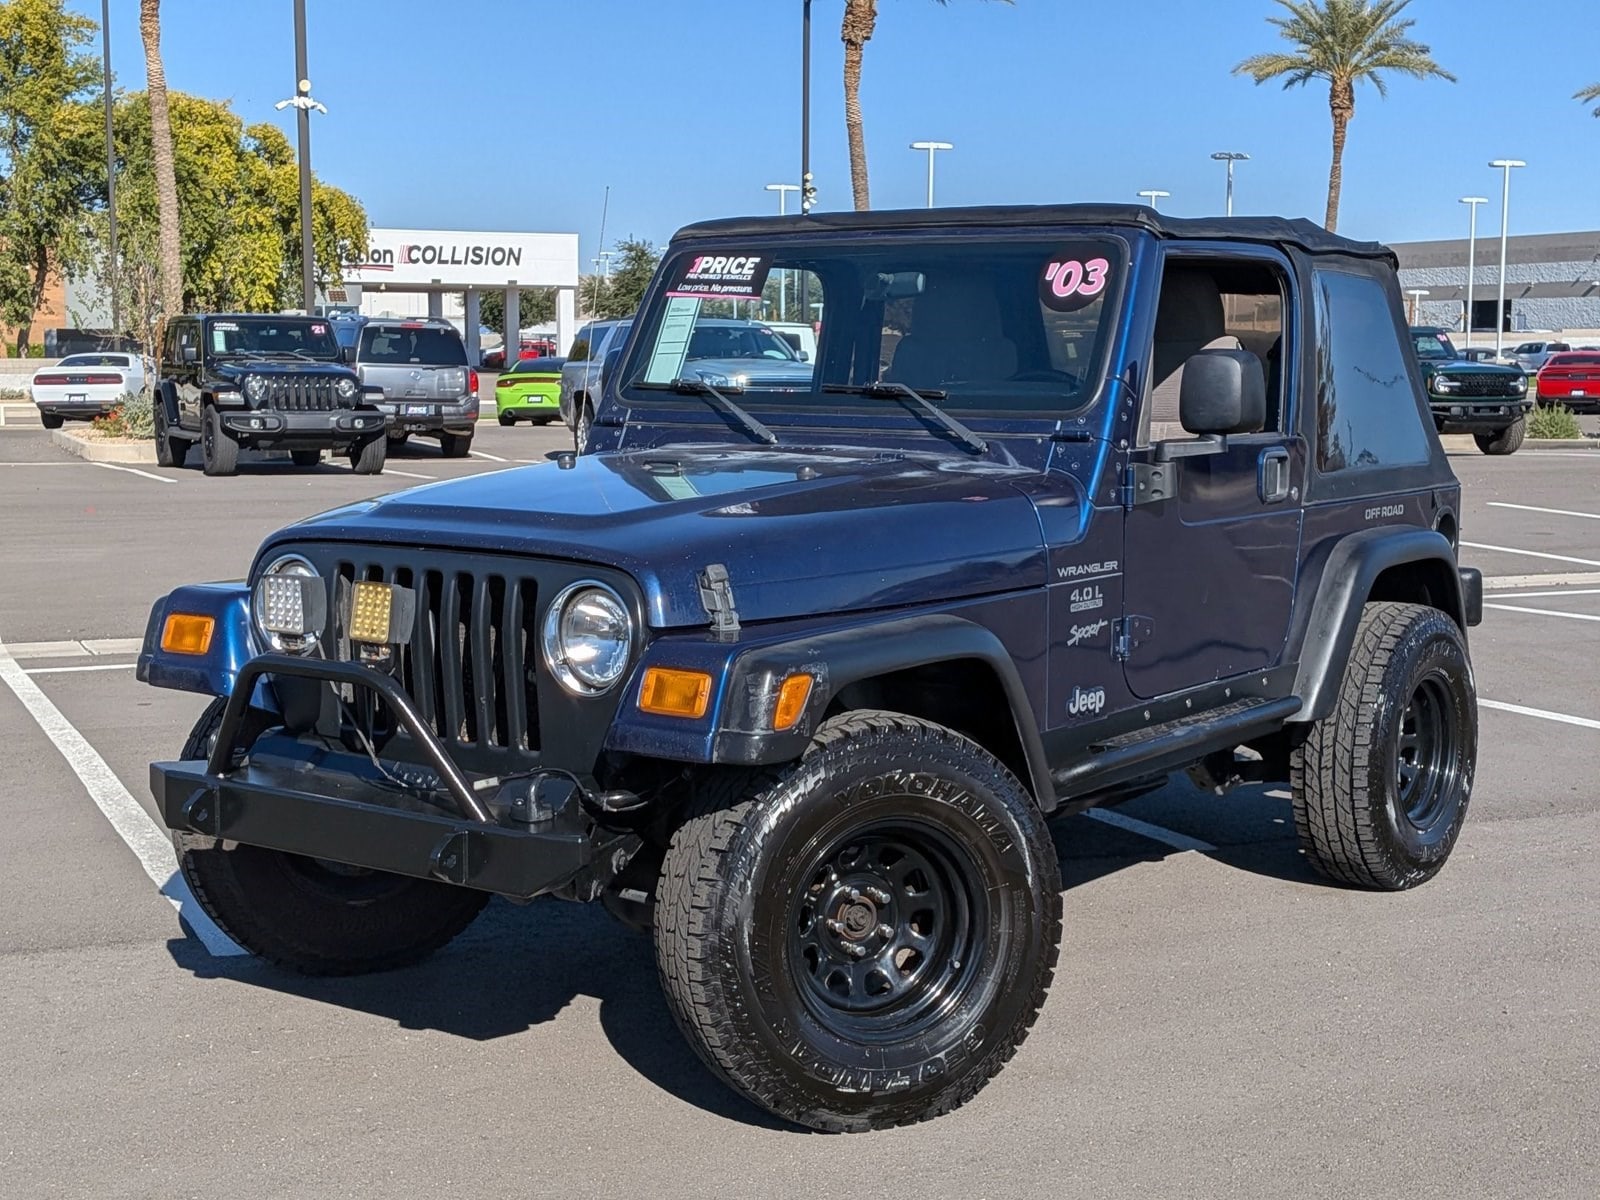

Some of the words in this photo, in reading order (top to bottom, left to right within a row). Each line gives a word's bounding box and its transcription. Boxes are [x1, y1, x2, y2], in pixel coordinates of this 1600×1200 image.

[408, 244, 522, 266] COLLISION
[677, 283, 692, 291] Low
[710, 283, 721, 292] No
[1045, 258, 1109, 297] '03
[1365, 507, 1381, 520] OFF
[1381, 504, 1404, 517] ROAD
[1057, 561, 1118, 577] WRANGLER
[1067, 619, 1108, 646] Sport
[1068, 689, 1105, 714] Jeep
[834, 769, 1013, 853] YOKOHAMA
